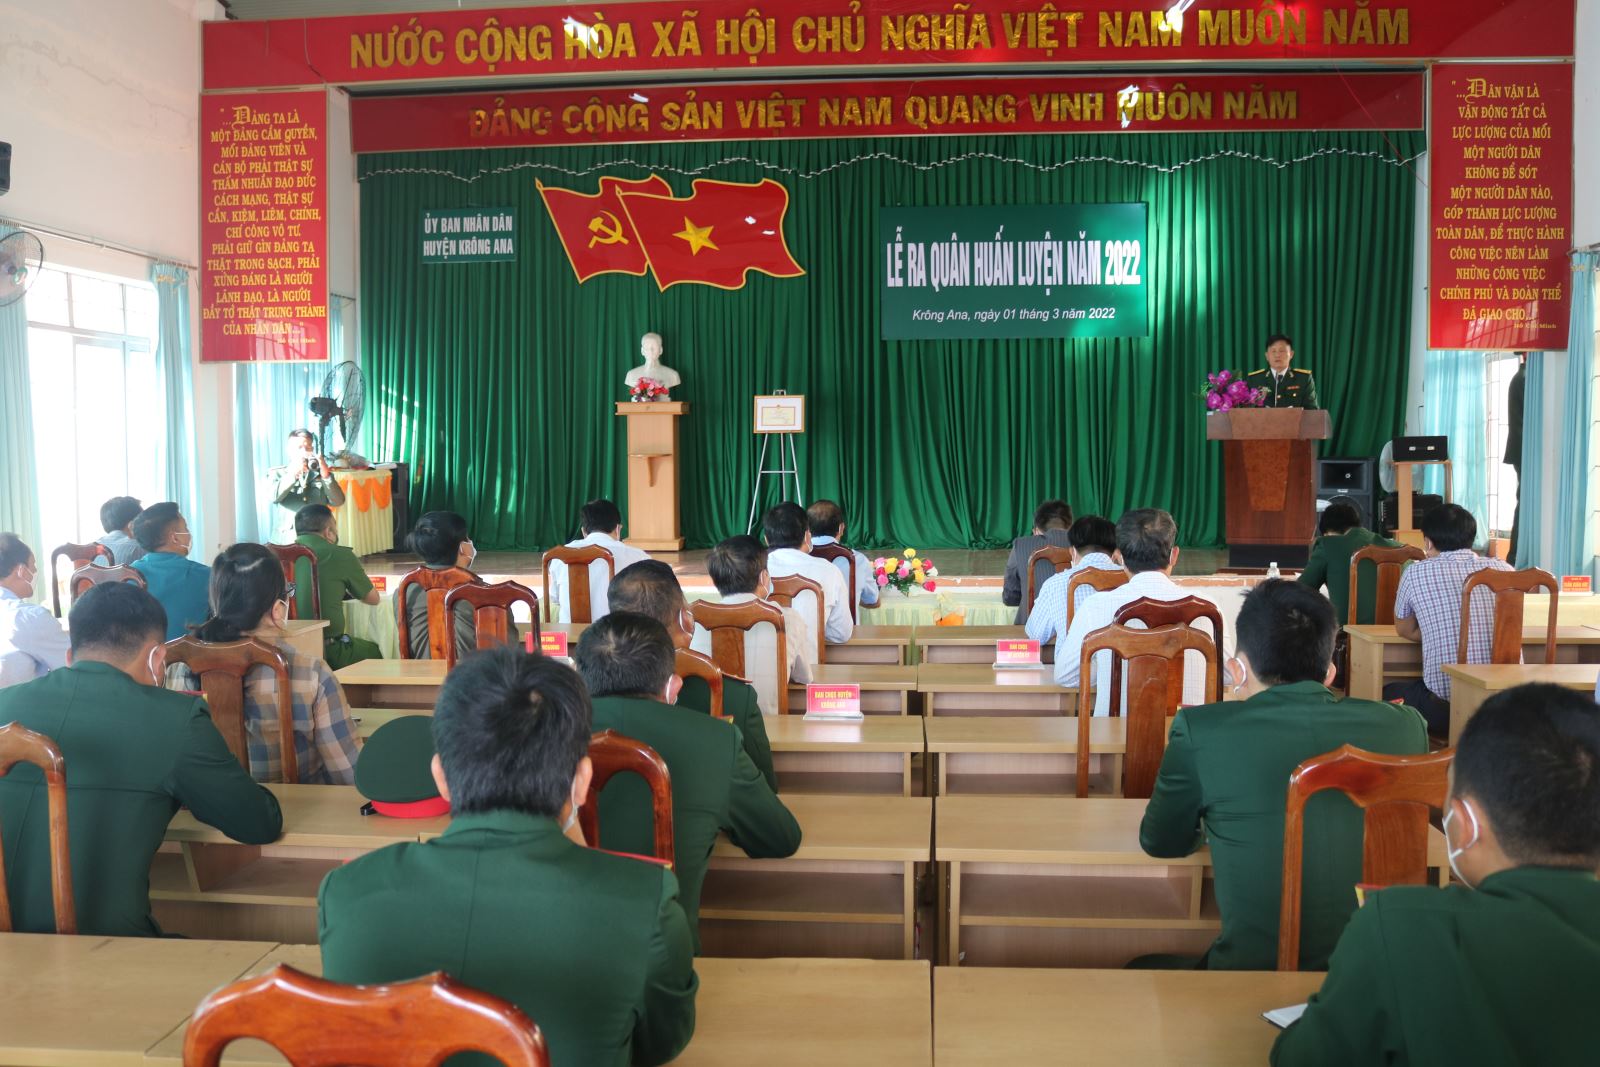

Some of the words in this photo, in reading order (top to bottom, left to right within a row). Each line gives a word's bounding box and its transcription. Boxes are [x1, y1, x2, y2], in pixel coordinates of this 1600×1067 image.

[350, 17, 444, 69] NƯỚC
[455, 17, 553, 72] CỘNG
[564, 12, 637, 60] HÒA
[651, 11, 701, 58] XÃ
[716, 8, 776, 64] HỘI
[792, 1, 866, 53] CHỦ
[881, 4, 995, 51] NGHĨA
[1001, 8, 1084, 57] VIỆT
[1099, 10, 1182, 48] NAM
[1199, 0, 1307, 47] MUÔN
[1323, 0, 1409, 45] NĂM
[1504, 84, 1524, 100] VẬN
[1527, 83, 1539, 98] LÀ
[273, 112, 285, 124] TA
[288, 109, 299, 123] LÀ
[469, 97, 552, 136] ĐẢNG
[660, 90, 723, 131] SẢN
[736, 92, 806, 136] VIỆT
[818, 97, 891, 128] NAM
[905, 93, 1016, 130] QUANG
[1028, 91, 1103, 123] VINH
[1116, 83, 1212, 121] MUÔN
[1223, 83, 1297, 121] NĂM
[1459, 104, 1478, 120] VẬN
[1481, 104, 1508, 120] ĐỘNG
[1511, 103, 1530, 118] TẤT
[1533, 103, 1546, 118] CẢ
[211, 129, 231, 144] MỘT
[233, 127, 258, 141] ĐẢNG
[1453, 125, 1471, 140] LỰC
[1475, 125, 1506, 140] LƯỢNG
[1510, 123, 1529, 138] CỦA
[241, 143, 266, 157] ĐẢNG
[269, 143, 290, 156] VIÊN
[294, 141, 306, 155] VÀ
[1464, 144, 1485, 160] MỘT
[1488, 143, 1517, 158] NGƯỜI
[1521, 144, 1541, 158] DÂN
[213, 161, 231, 174] CÁN
[234, 161, 246, 175] BỘ
[249, 159, 271, 172] PHẢI
[274, 159, 298, 173] THẬT
[301, 158, 313, 173] SỰ
[1465, 164, 1499, 178] KHÔNG
[1503, 162, 1515, 178] ĐỂ
[1519, 164, 1537, 178] SÓT
[275, 177, 294, 189] ĐẠO
[297, 173, 316, 187] ĐỨC
[214, 192, 239, 206] CÁCH
[274, 191, 298, 206] THẬT
[301, 191, 313, 205] SỰ
[1451, 184, 1472, 201] MỘT
[1475, 184, 1504, 199] NGƯỜI
[1507, 185, 1527, 199] DÂN
[1444, 204, 1463, 219] GÓP
[1466, 204, 1499, 219] THÀNH
[1503, 206, 1521, 222] LỰC
[1524, 206, 1557, 222] LƯỢNG
[226, 224, 242, 238] CHÍ
[245, 224, 270, 237] CÔNG
[272, 224, 284, 237] VÔ
[425, 213, 438, 233] ỦY
[441, 217, 460, 233] BAN
[463, 213, 489, 232] NHÂN
[492, 213, 512, 231] DÂN
[1436, 224, 1461, 239] TOÀN
[1490, 222, 1503, 239] ĐỂ
[1507, 226, 1533, 242] THỰC
[1537, 225, 1564, 239] HÀNH
[212, 240, 233, 254] PHẢI
[255, 239, 271, 253] GÌN
[274, 239, 299, 252] ĐẢNG
[302, 241, 314, 252] TA
[424, 237, 456, 259] HUYỆN
[459, 236, 490, 255] KRÔNG
[494, 239, 513, 254] ANA
[1450, 245, 1476, 259] CÔNG
[1480, 245, 1502, 261] VIỆC
[1505, 245, 1524, 259] NÊN
[1528, 244, 1548, 259] LÀM
[207, 257, 231, 272] THẬT
[234, 258, 265, 270] TRONG
[297, 254, 320, 268] PHẢI
[887, 226, 903, 287] LỄ
[908, 243, 926, 287] RA
[930, 232, 970, 292] QUÂN
[974, 225, 1013, 286] HUẤN
[1018, 231, 1063, 296] LUYỆN
[1067, 231, 1101, 285] NĂM
[1104, 240, 1141, 285] 2022
[242, 272, 266, 285] ĐÁNG
[270, 270, 281, 285] LÀ
[284, 270, 312, 284] NGƯỜI
[1493, 265, 1519, 280] CÔNG
[1522, 266, 1545, 282] VIỆC
[268, 288, 279, 302] LÀ
[282, 287, 310, 301] NGƯỜI
[1440, 284, 1470, 300] CHÍNH
[1474, 284, 1493, 300] PHỦ
[1496, 285, 1509, 300] VÀ
[1512, 284, 1538, 300] ĐOÀN
[237, 303, 260, 320] THẬT
[263, 306, 293, 317] TRUNG
[295, 303, 326, 317] THÀNH
[913, 308, 944, 322] Krông
[946, 309, 970, 321] Ana,
[974, 310, 1000, 322] ngày
[1003, 309, 1015, 320] 01
[1019, 308, 1049, 321] tháng
[1053, 309, 1059, 319] 3
[1062, 309, 1085, 319] năm
[1088, 308, 1115, 319] 2022
[1480, 308, 1502, 320] GIAO
[223, 321, 241, 335] CỦA
